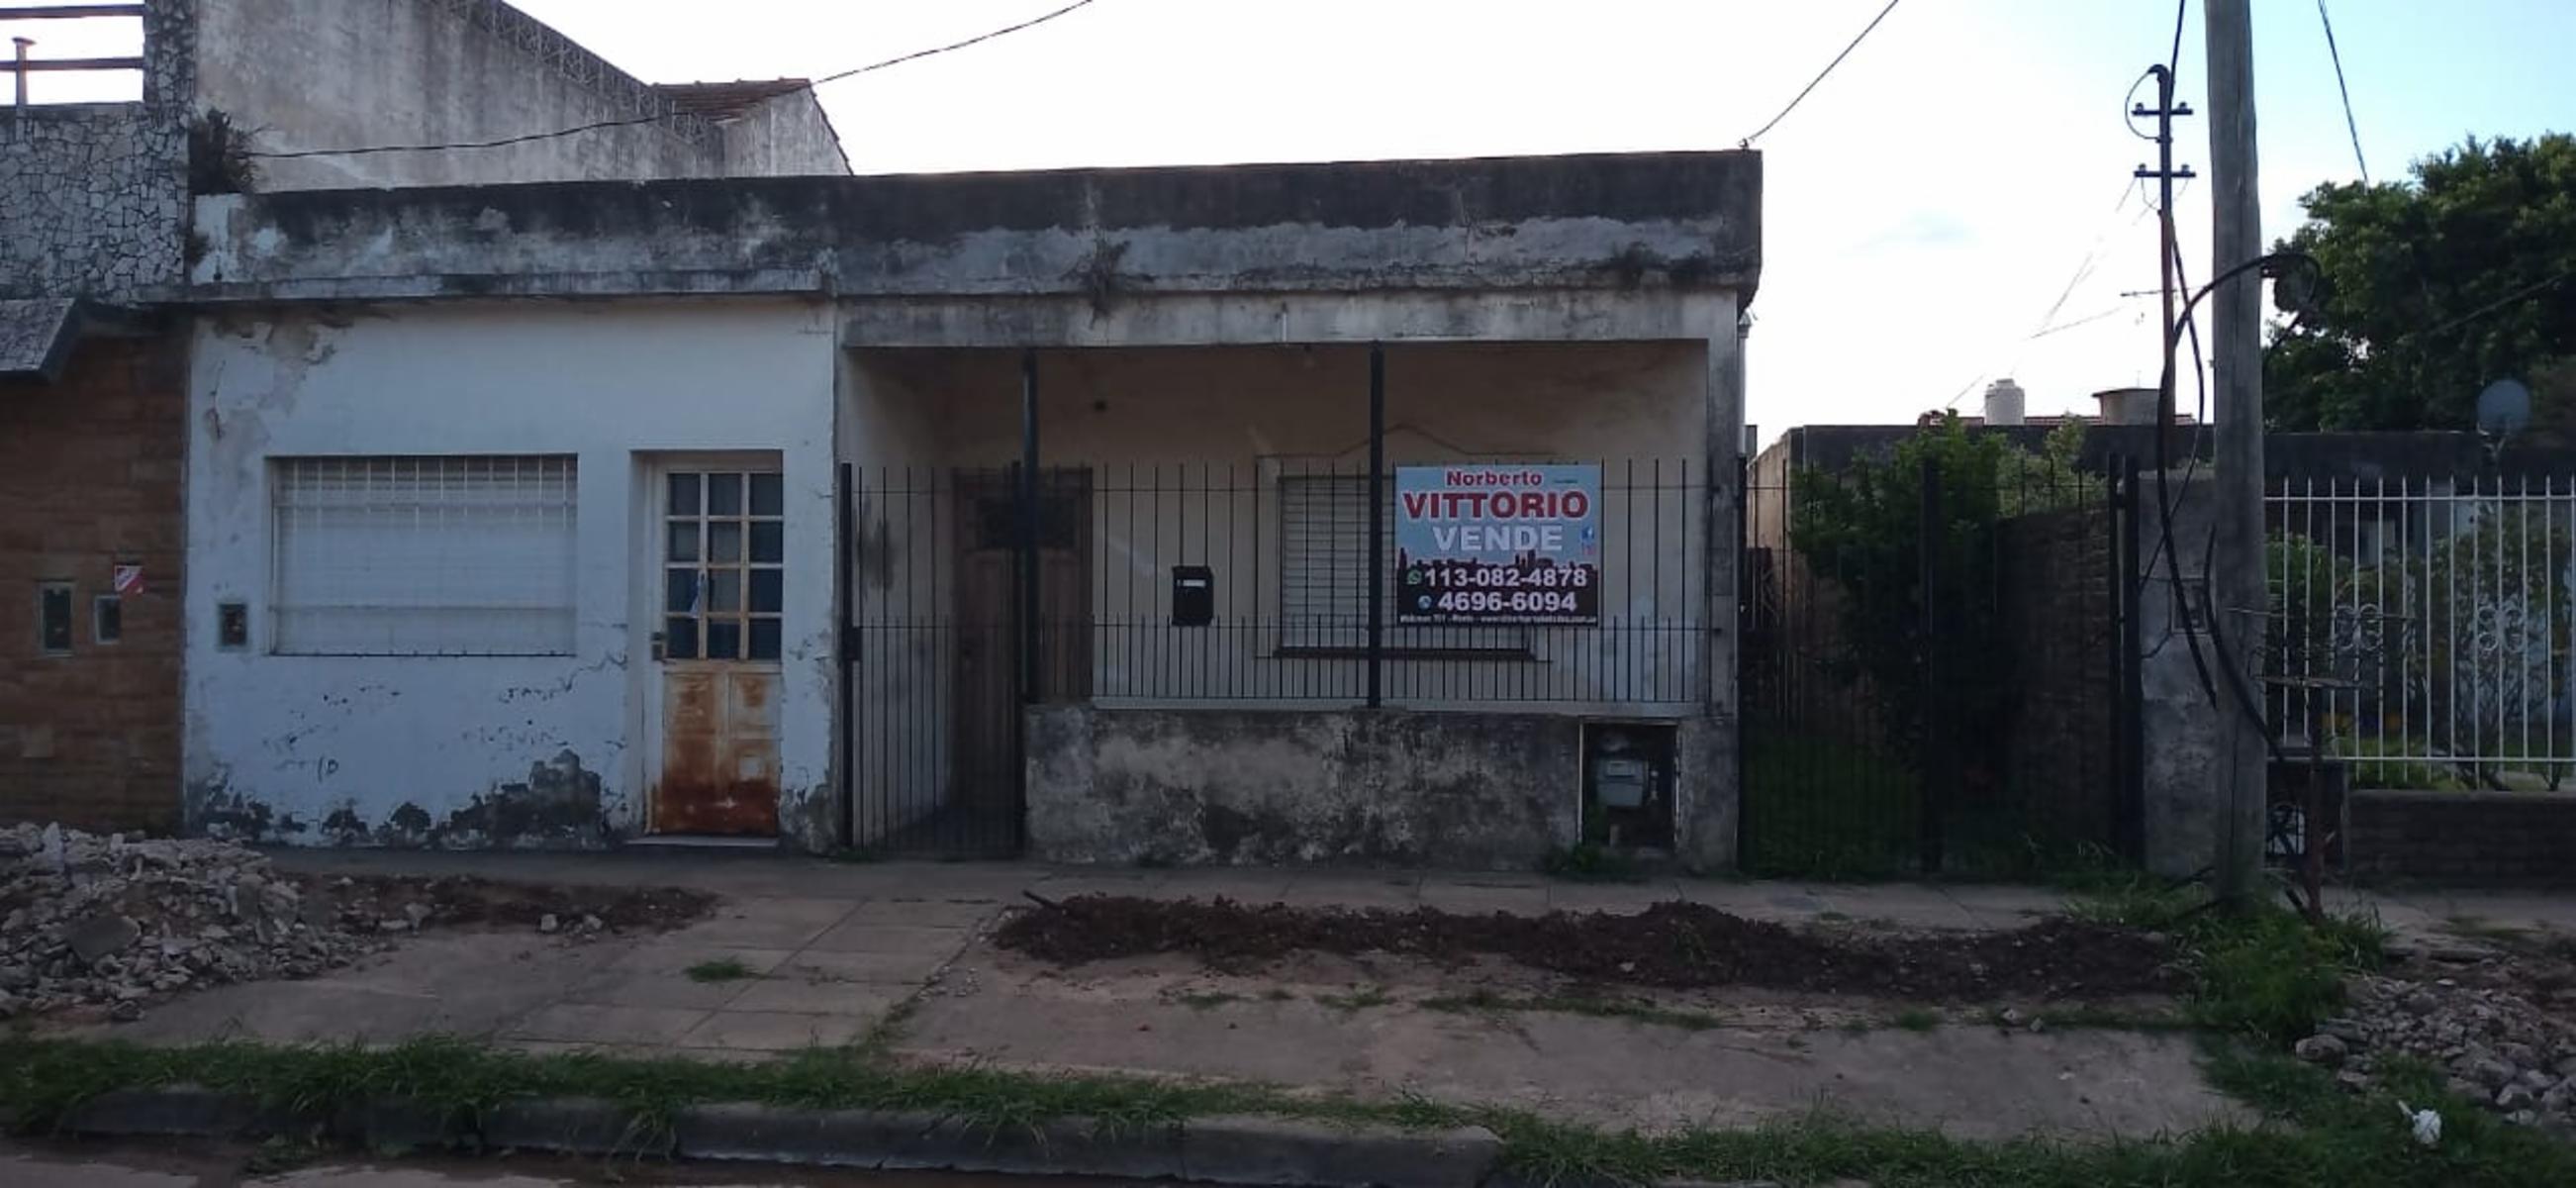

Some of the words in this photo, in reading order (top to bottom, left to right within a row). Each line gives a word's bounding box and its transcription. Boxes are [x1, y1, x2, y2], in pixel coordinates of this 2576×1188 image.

[1446, 470, 1543, 487] Norberto
[1402, 491, 1589, 520] VITTORIO
[1433, 526, 1563, 551] VENDE
[1425, 568, 1587, 587] 113-082-4878
[1438, 591, 1576, 612] 4696-6094
